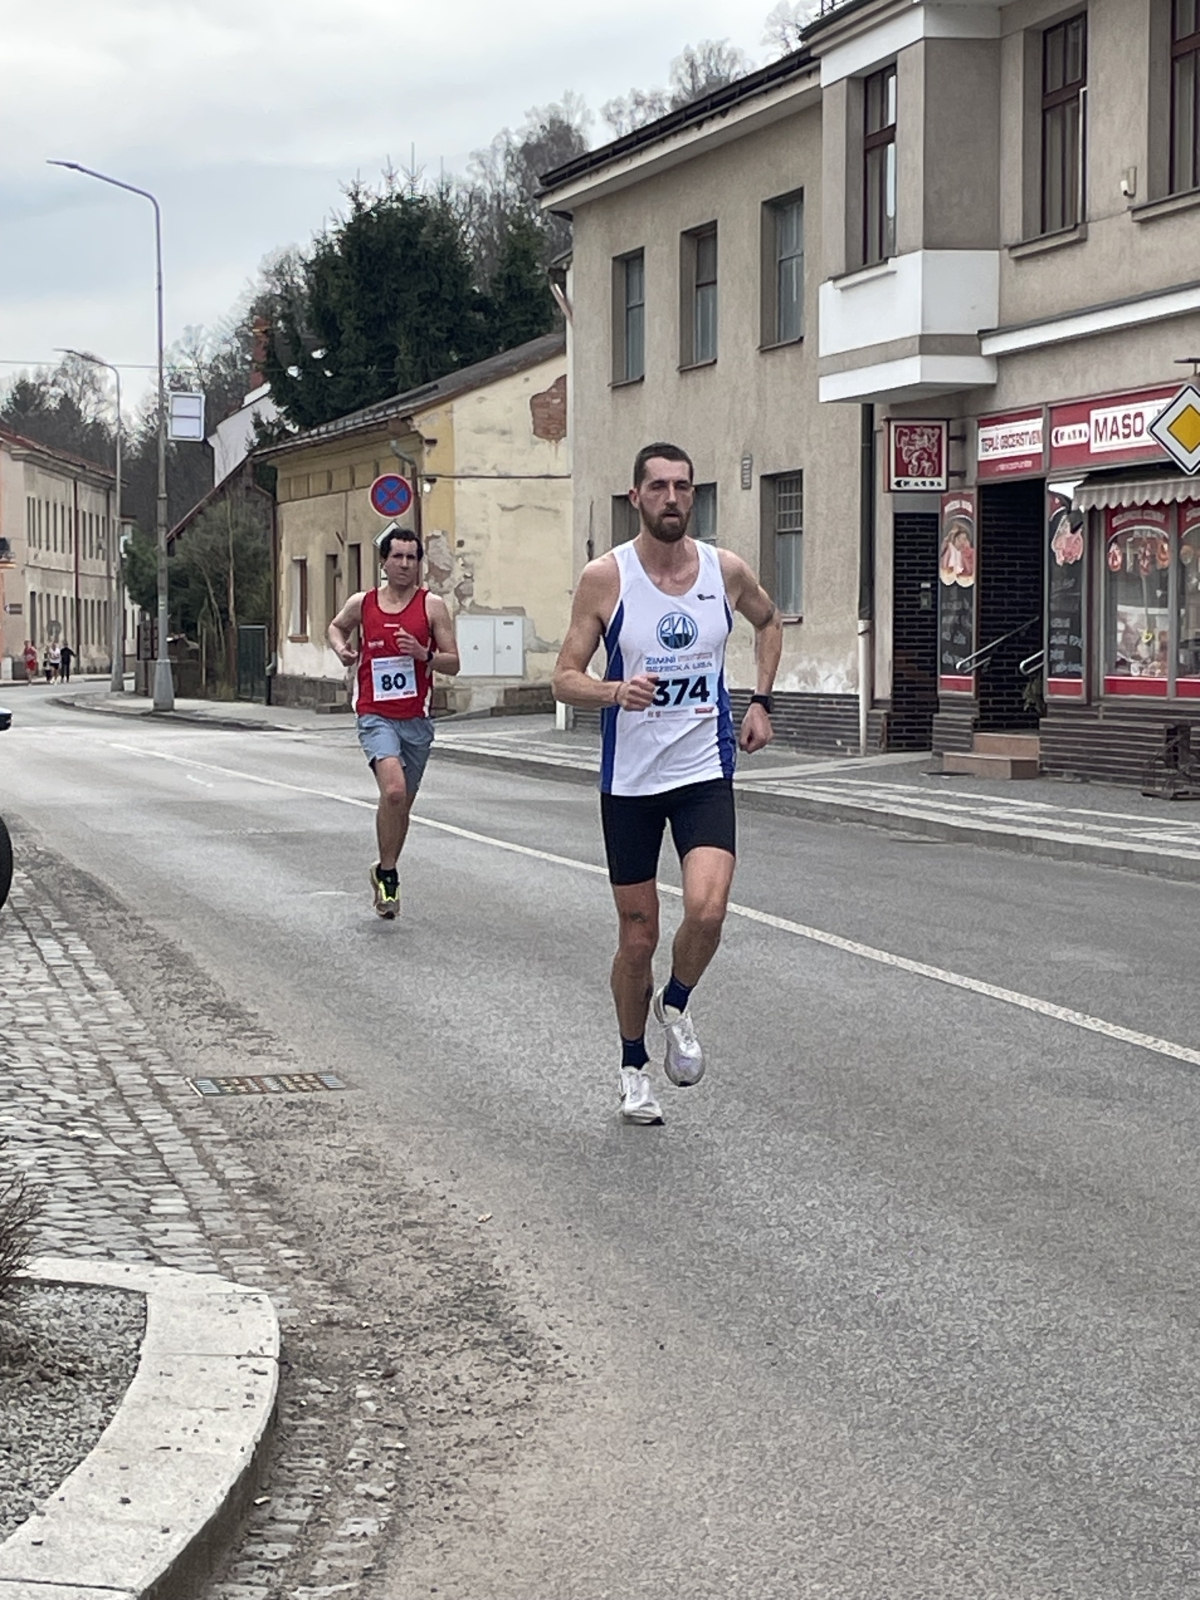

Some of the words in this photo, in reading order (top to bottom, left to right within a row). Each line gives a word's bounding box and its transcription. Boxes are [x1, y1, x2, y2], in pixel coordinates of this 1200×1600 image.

[1094, 411, 1145, 443] MASO
[381, 672, 406, 691] 80
[653, 675, 710, 706] 374
